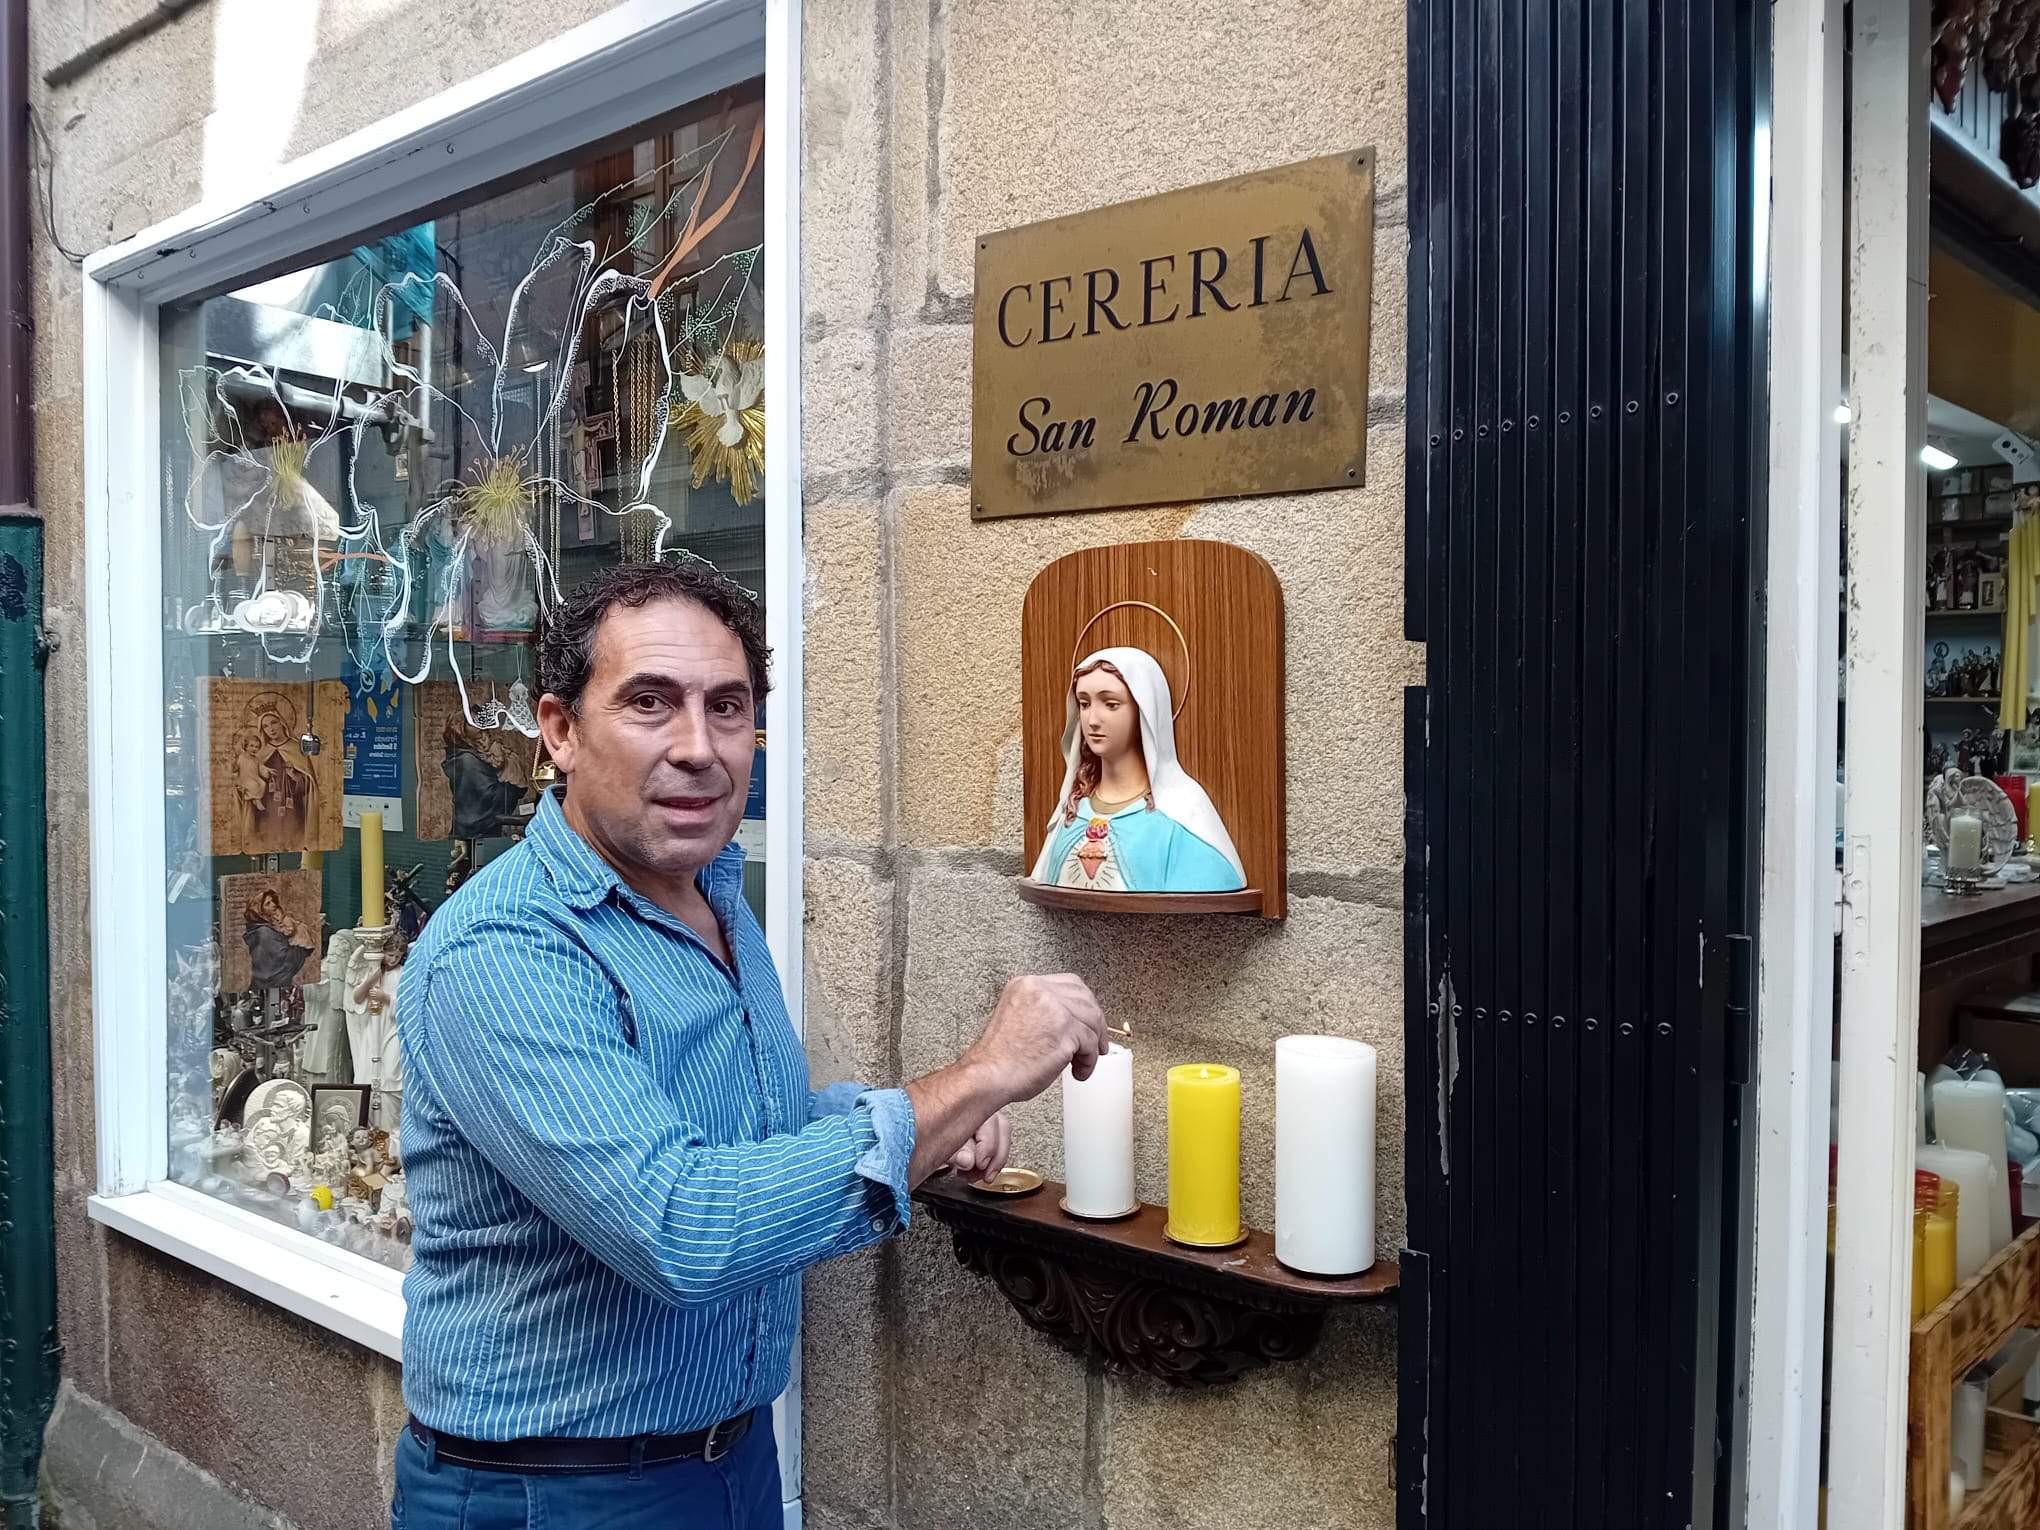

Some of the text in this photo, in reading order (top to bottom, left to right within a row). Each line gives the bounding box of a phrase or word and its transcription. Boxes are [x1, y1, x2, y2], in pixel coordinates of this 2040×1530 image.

[997, 227, 1335, 348] CERERIA
[1006, 377, 1317, 457] San Roman
